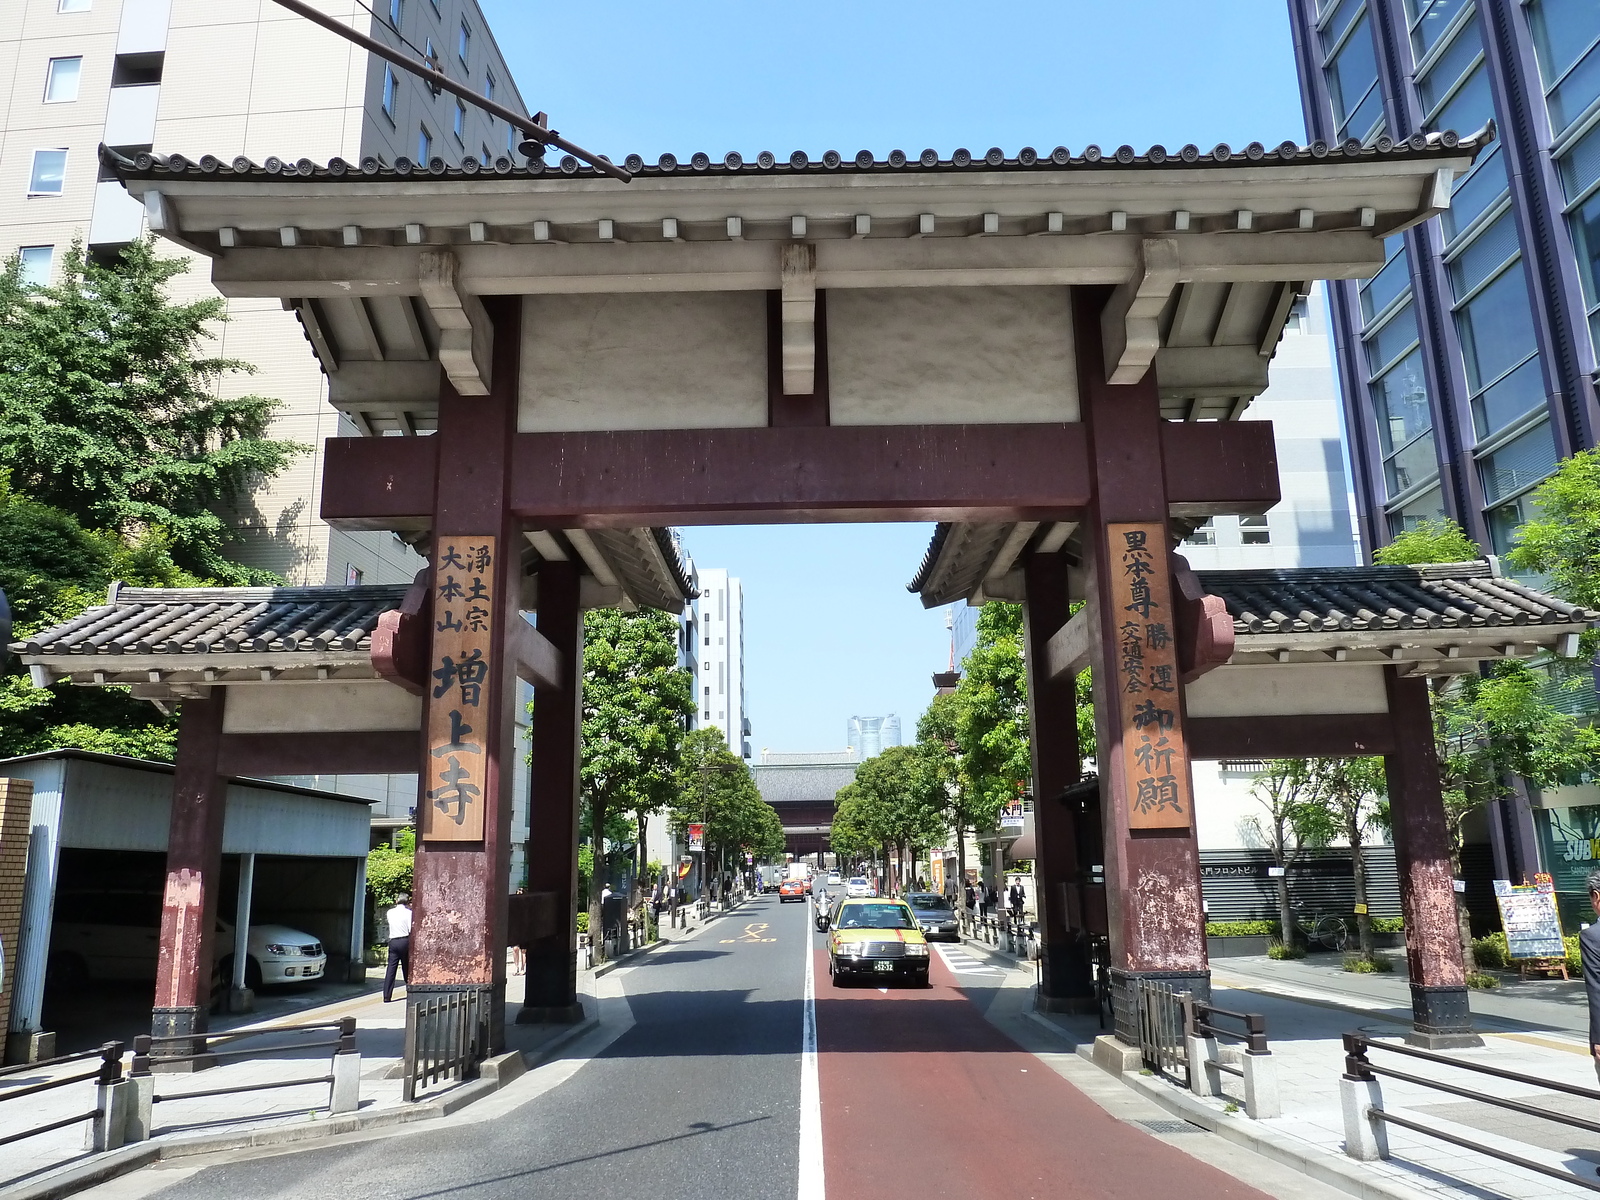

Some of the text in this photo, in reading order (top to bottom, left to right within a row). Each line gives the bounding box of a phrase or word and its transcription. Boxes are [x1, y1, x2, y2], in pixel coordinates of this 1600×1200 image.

[437, 545, 465, 632] 大本山
[1120, 621, 1147, 693] 交通安全
[1145, 623, 1174, 692] 勝運
[427, 648, 488, 826] 増上寺
[1133, 699, 1183, 815] 御祈願
[1002, 804, 1022, 816] 大門
